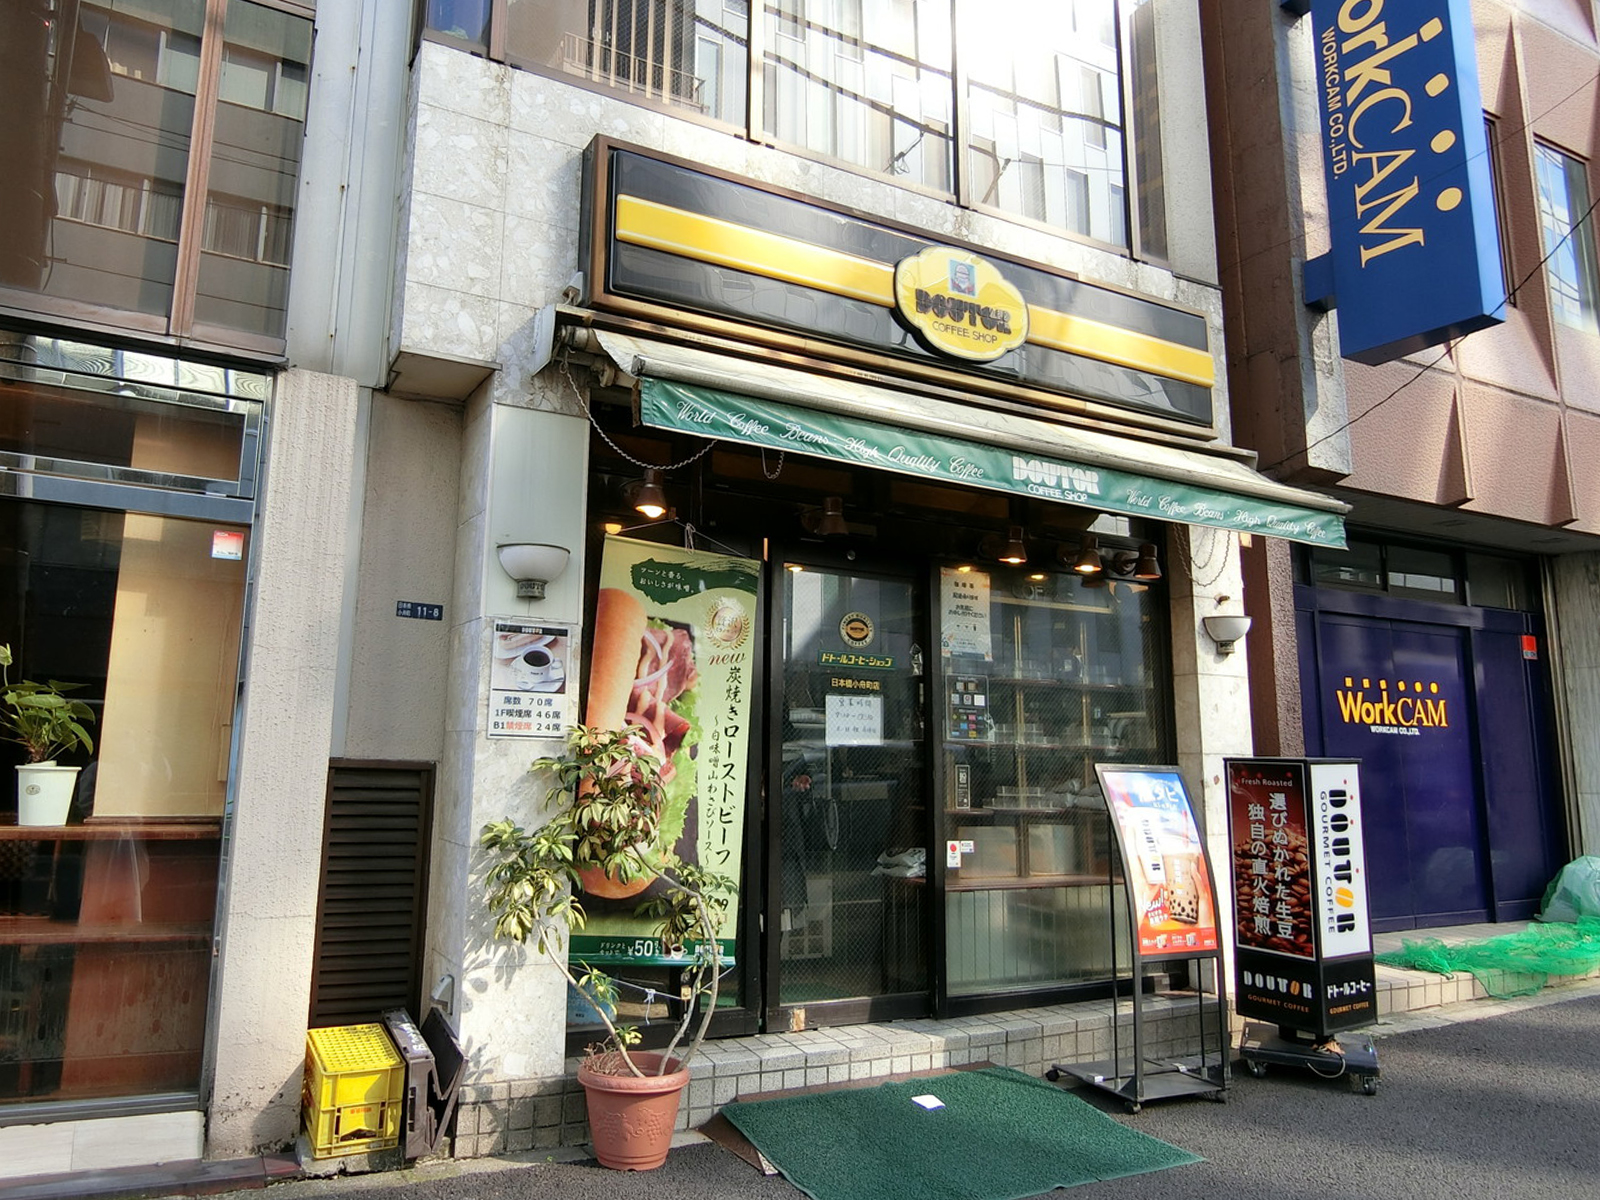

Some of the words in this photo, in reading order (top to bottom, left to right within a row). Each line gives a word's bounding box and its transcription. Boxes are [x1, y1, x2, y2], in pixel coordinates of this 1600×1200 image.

[1321, 27, 1342, 112] WORKCAM
[1329, 113, 1347, 180] CO.,LTD.
[915, 288, 1012, 335] DOUTOR
[932, 321, 970, 338] COFFEE
[972, 330, 998, 344] SHOP
[676, 401, 717, 425] World
[726, 411, 769, 436] Coffee
[780, 422, 830, 446] Beans
[844, 437, 880, 460] High
[887, 446, 941, 472] Quality
[950, 456, 985, 480] Coffee
[1012, 456, 1100, 494] DOUTOR
[1027, 484, 1063, 499] COFFEE
[1064, 489, 1088, 502] SHOP
[1126, 489, 1150, 508] World
[1157, 495, 1186, 516] Coffee
[1194, 503, 1225, 522] Beans
[1233, 509, 1261, 527] High
[1266, 514, 1300, 535] Quality
[1303, 521, 1327, 539] Coffee
[417, 606, 439, 617] 11-8
[709, 652, 746, 665] new
[821, 653, 892, 667] ドトールコーヒーショップ
[503, 696, 521, 705] 席数
[1336, 690, 1448, 727] WorkCAM
[1370, 725, 1398, 734] WORKCAM
[715, 666, 742, 865] 炭焼きローストビーフ
[1242, 778, 1260, 786] Fresh
[1262, 779, 1293, 787] Roasted
[1320, 791, 1331, 867] GOURMET
[1248, 803, 1271, 935] 独自の直火焙煎
[1269, 793, 1294, 940] 選びぬかれた生豆
[1329, 790, 1355, 933] DOUTOR
[1325, 876, 1336, 933] COFFEE
[1243, 970, 1312, 999] DOUTOR
[1327, 979, 1372, 999] ドトールコーヒー
[1248, 994, 1281, 1006] GOURMET
[1284, 1002, 1309, 1013] COFFEE
[1330, 1004, 1351, 1015] GOURMET
[1353, 1001, 1369, 1011] COFFEE
